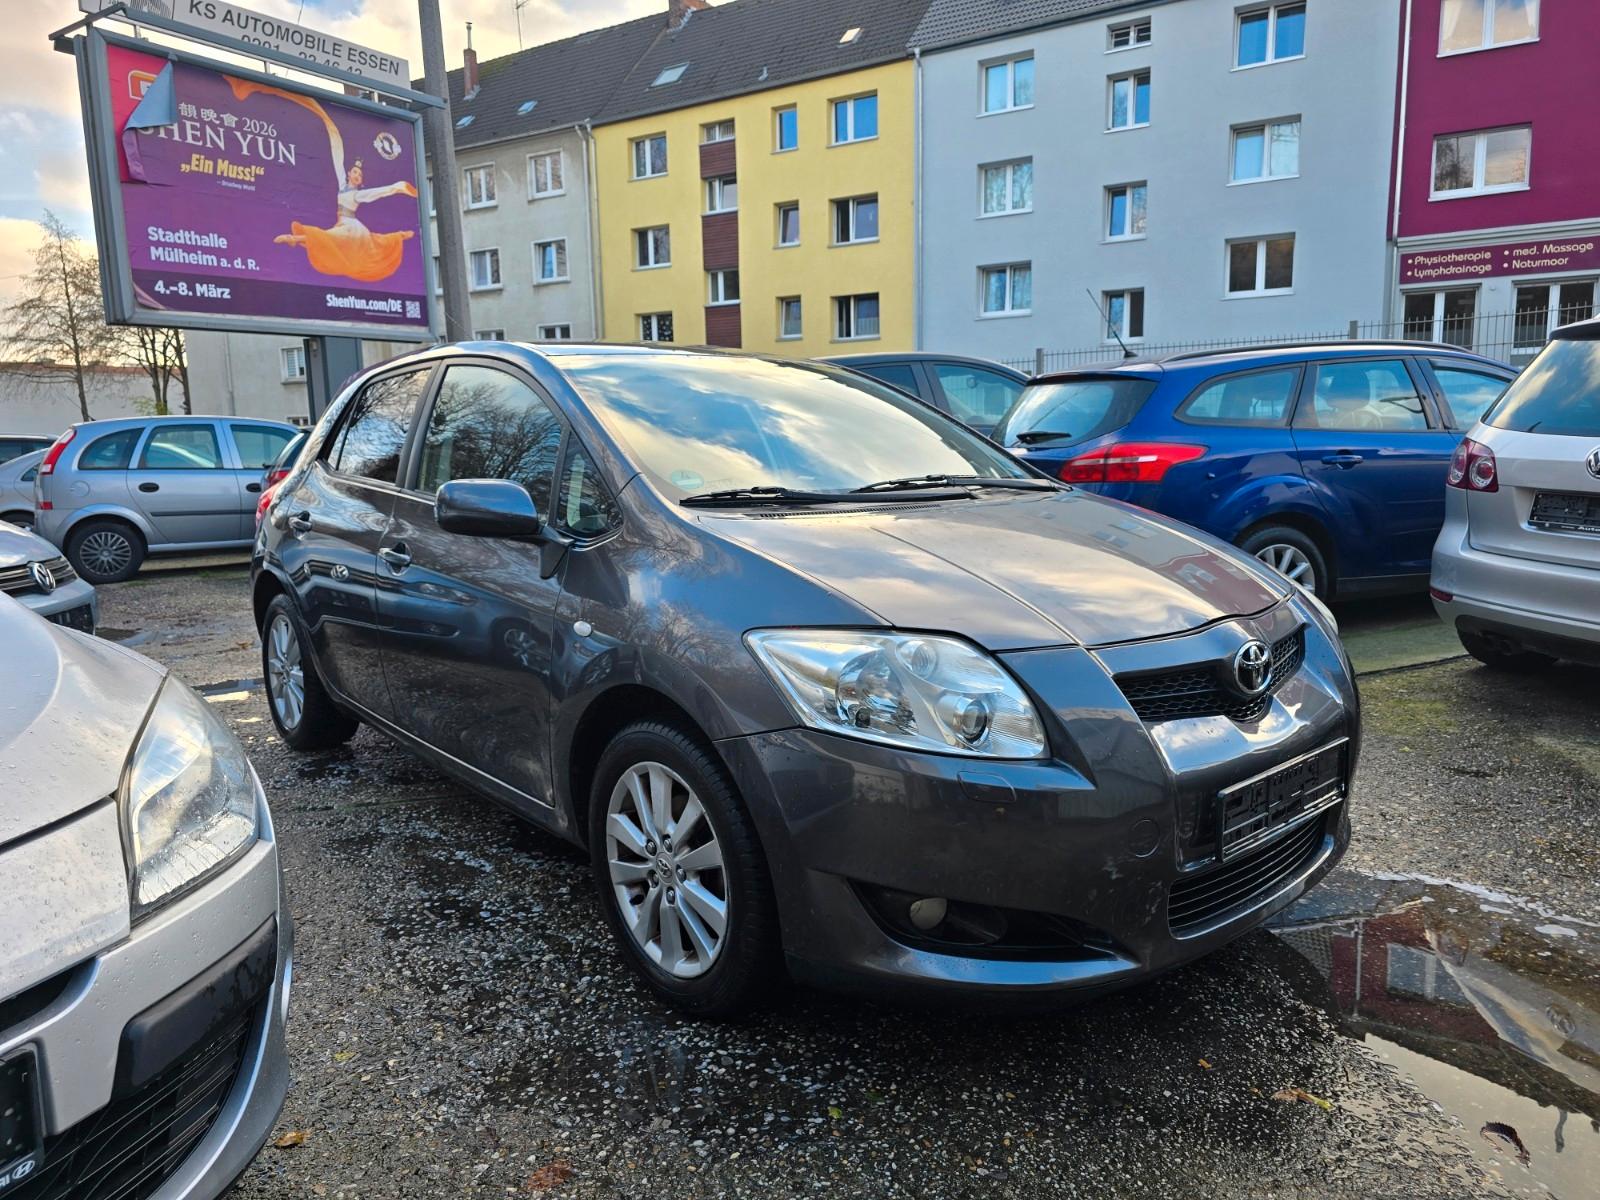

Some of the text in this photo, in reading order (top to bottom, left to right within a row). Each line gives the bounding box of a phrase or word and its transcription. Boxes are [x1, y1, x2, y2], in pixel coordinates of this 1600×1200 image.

[189, 0, 216, 20] KS
[221, 9, 342, 58] AUTOMOBILE
[347, 47, 400, 76] ESSEN
[242, 117, 277, 137] 2026
[137, 119, 296, 166] HEN YUN
[148, 226, 228, 249] Stadthalle
[150, 246, 260, 271] Mülheim a. d. R.
[1414, 251, 1492, 266] Physiotherapie
[1513, 242, 1594, 257] med. Massage
[1414, 263, 1492, 280] Lymphdrainage
[1512, 257, 1569, 269] Naturmoor
[195, 283, 231, 299] März
[326, 294, 403, 313] ShenYun.com/DE
